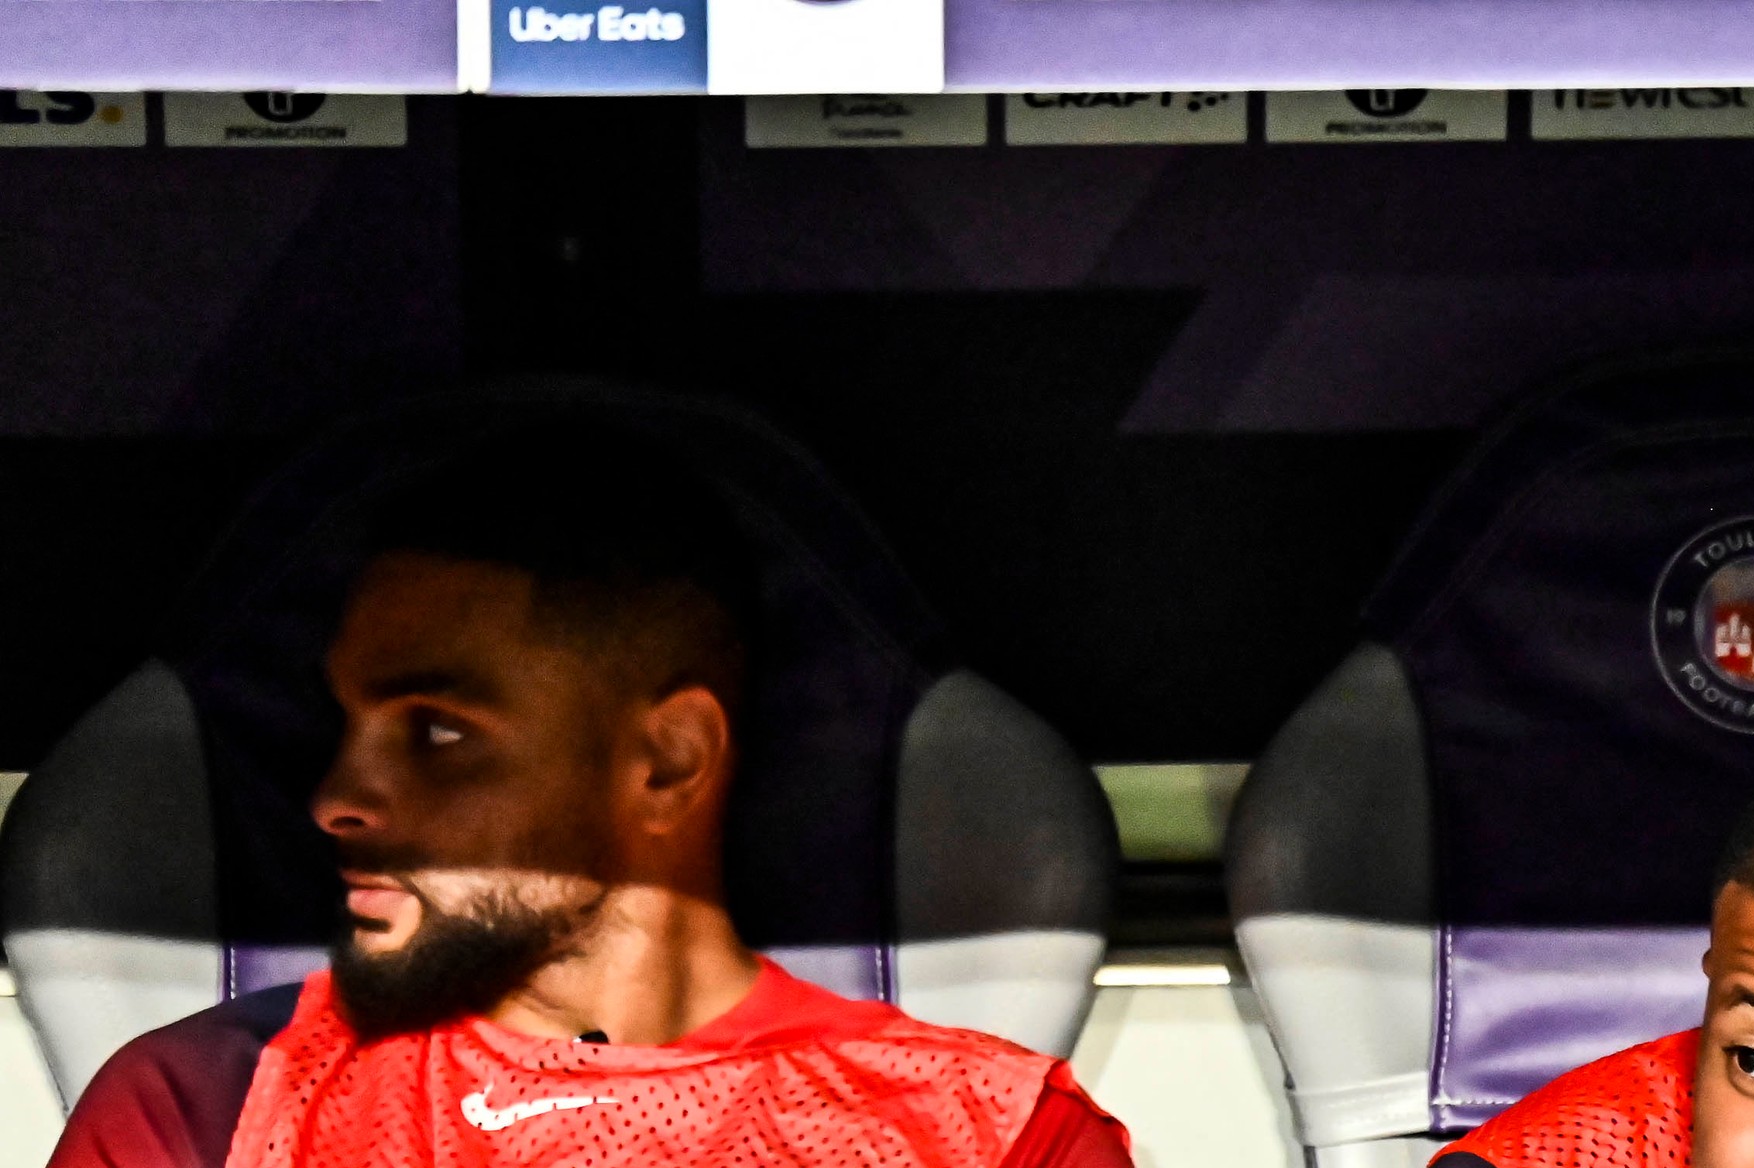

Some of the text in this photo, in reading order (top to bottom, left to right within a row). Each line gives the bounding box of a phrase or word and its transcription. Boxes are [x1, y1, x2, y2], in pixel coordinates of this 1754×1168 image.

[509, 6, 685, 42] Uber Eats
[225, 126, 346, 139] PROMOTION
